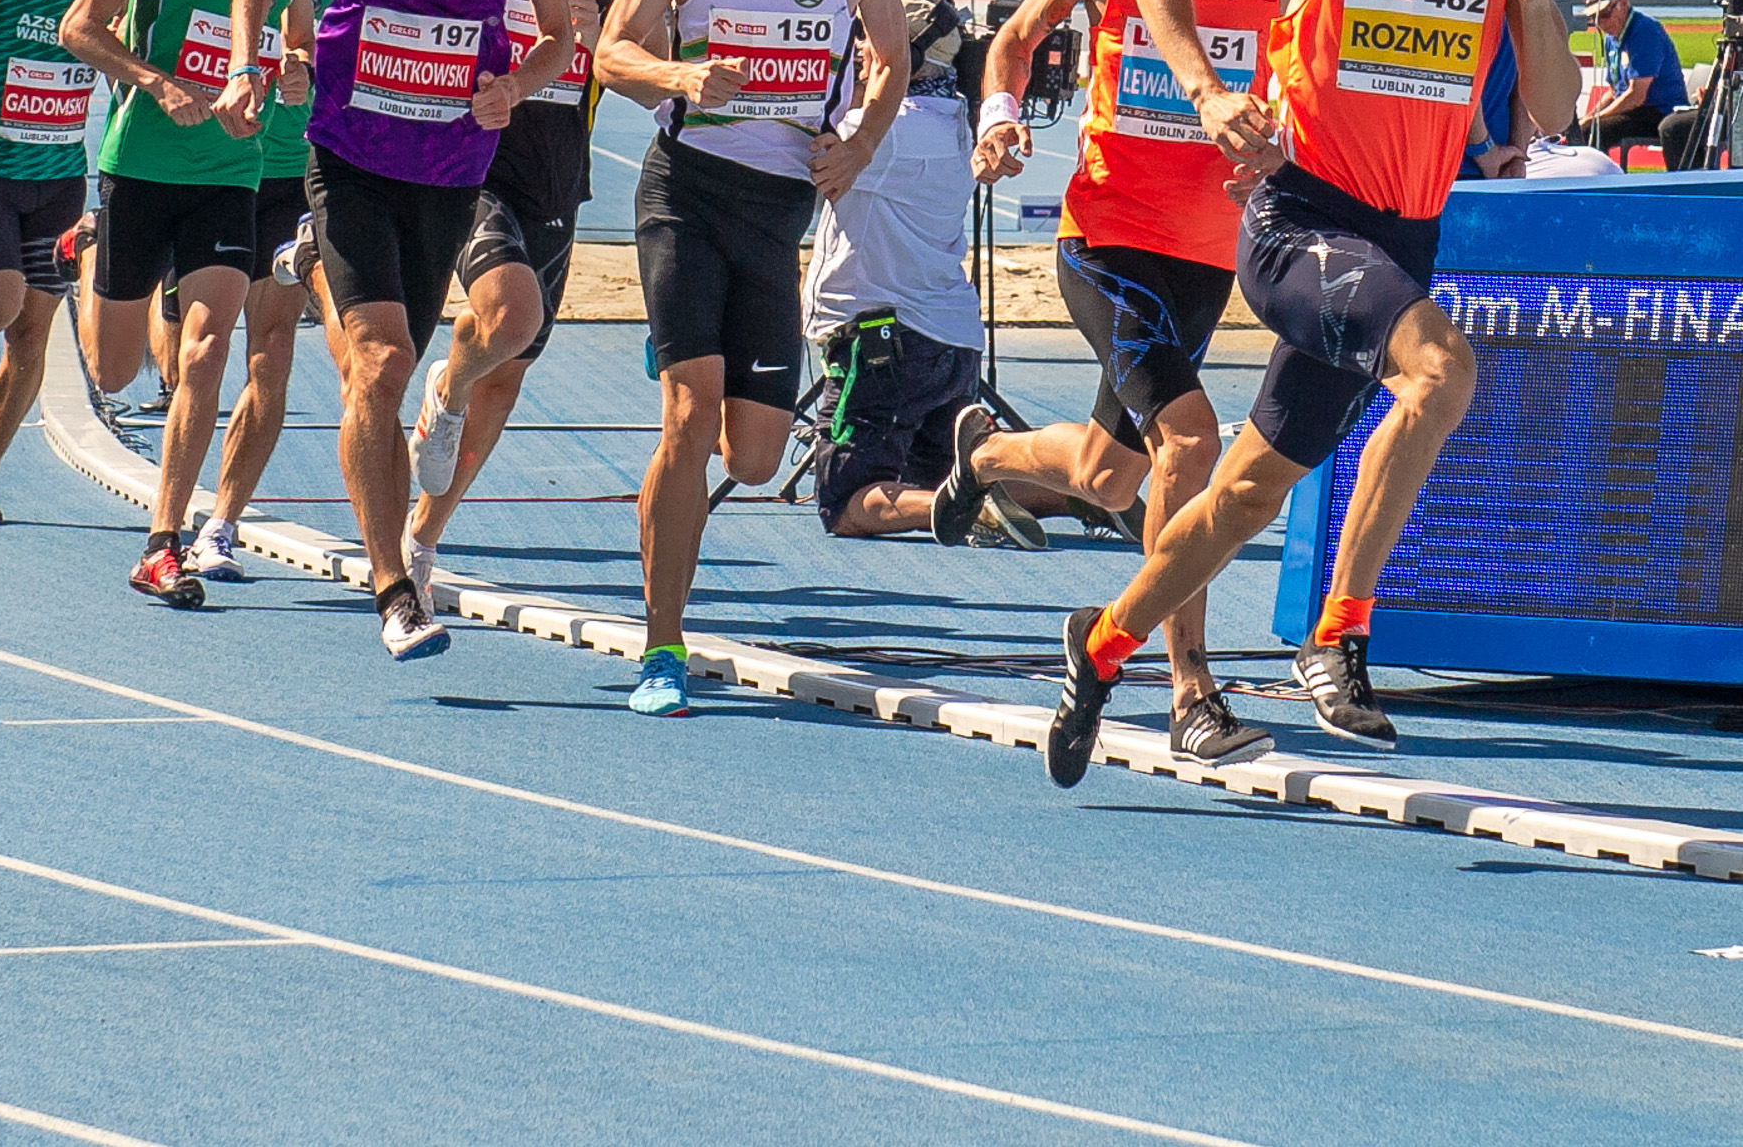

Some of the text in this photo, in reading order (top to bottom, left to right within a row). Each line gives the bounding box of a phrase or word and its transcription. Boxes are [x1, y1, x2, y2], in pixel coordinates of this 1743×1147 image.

[18, 12, 56, 31] AZS
[777, 18, 832, 42] 150
[430, 22, 480, 48] 197
[1350, 20, 1473, 61] ROZMYS
[1209, 35, 1245, 61] 51
[62, 67, 98, 85] 163
[359, 50, 471, 89] KWIATKOWSKI
[1371, 78, 1446, 98] LUBLIN 2018
[5, 93, 88, 117] GADOMSKI
[378, 100, 442, 119] LUBLIN 2018
[732, 104, 799, 116] LUBLIN 2018
[1143, 123, 1212, 141] LUBLIN 201
[880, 324, 891, 340] 6
